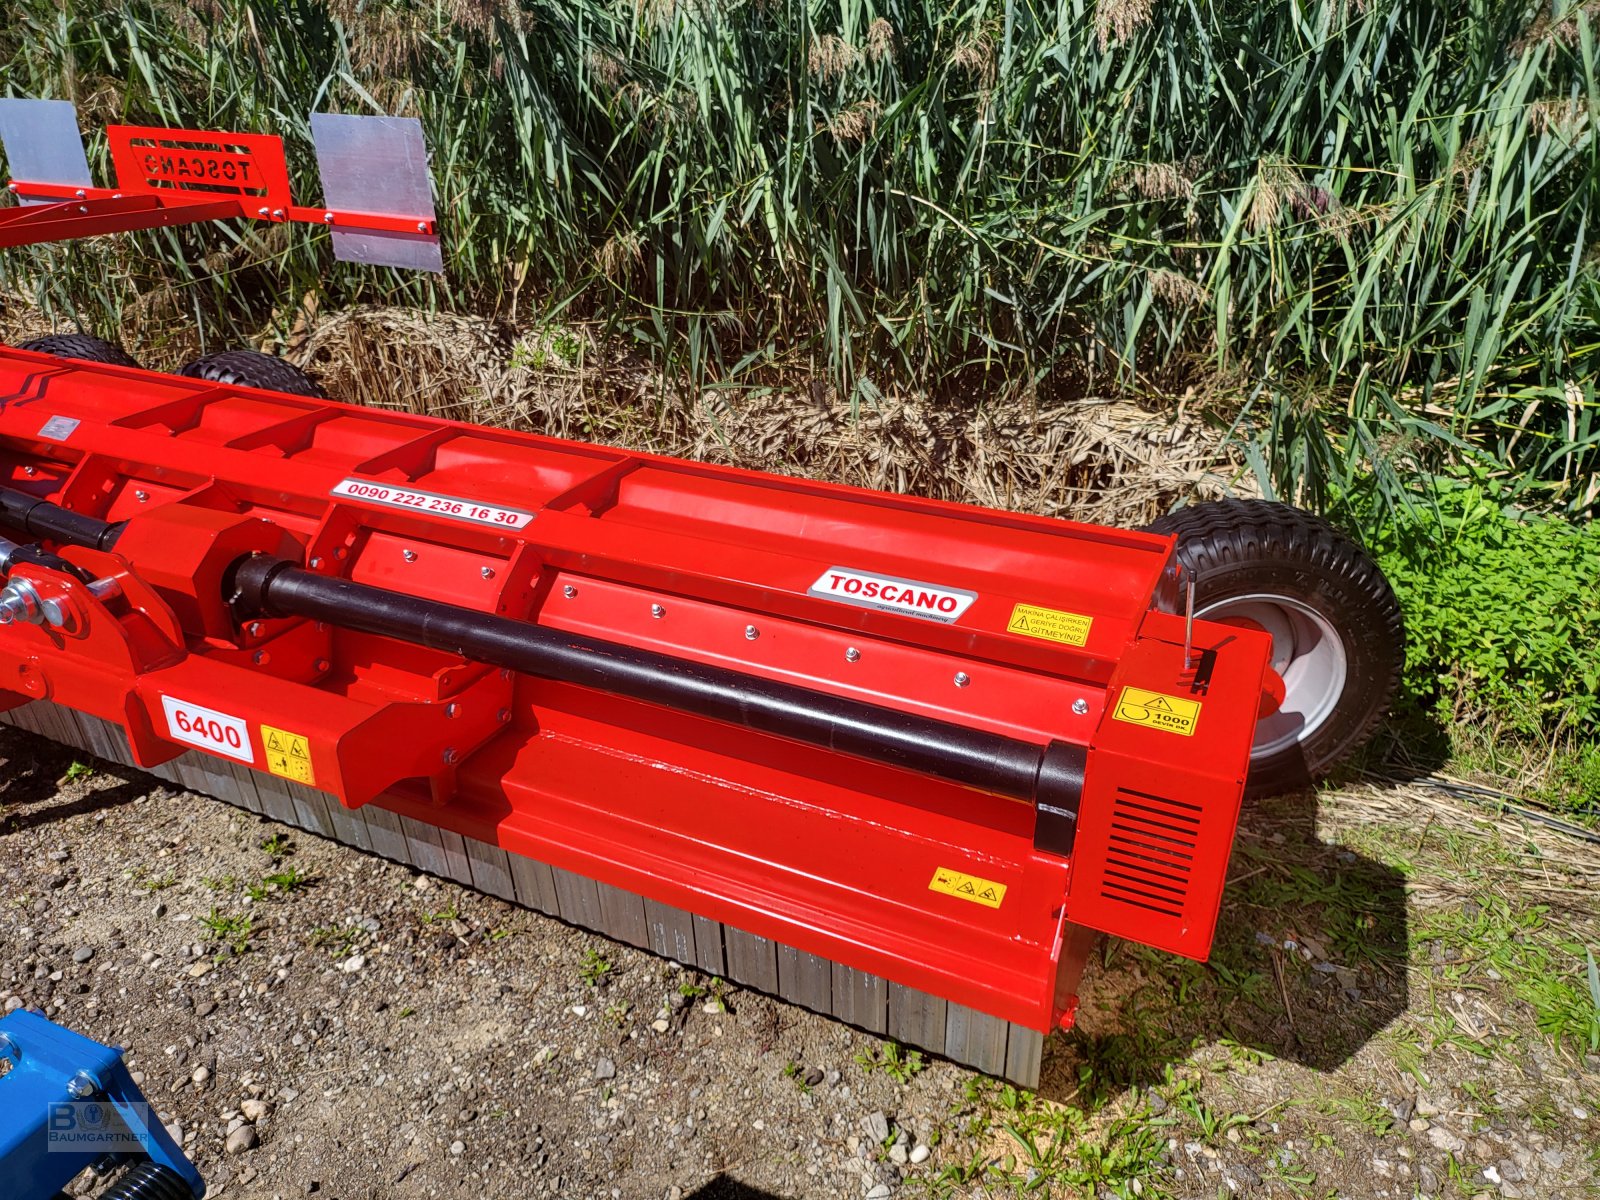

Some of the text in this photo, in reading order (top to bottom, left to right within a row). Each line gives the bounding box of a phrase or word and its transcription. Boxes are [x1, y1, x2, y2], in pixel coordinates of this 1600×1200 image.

[348, 484, 518, 525] 0090 222 236 16 30
[830, 575, 957, 613] TOSCANO
[877, 605, 948, 623] agricultural machinery
[175, 710, 241, 748] 6400
[1155, 713, 1189, 726] 1000
